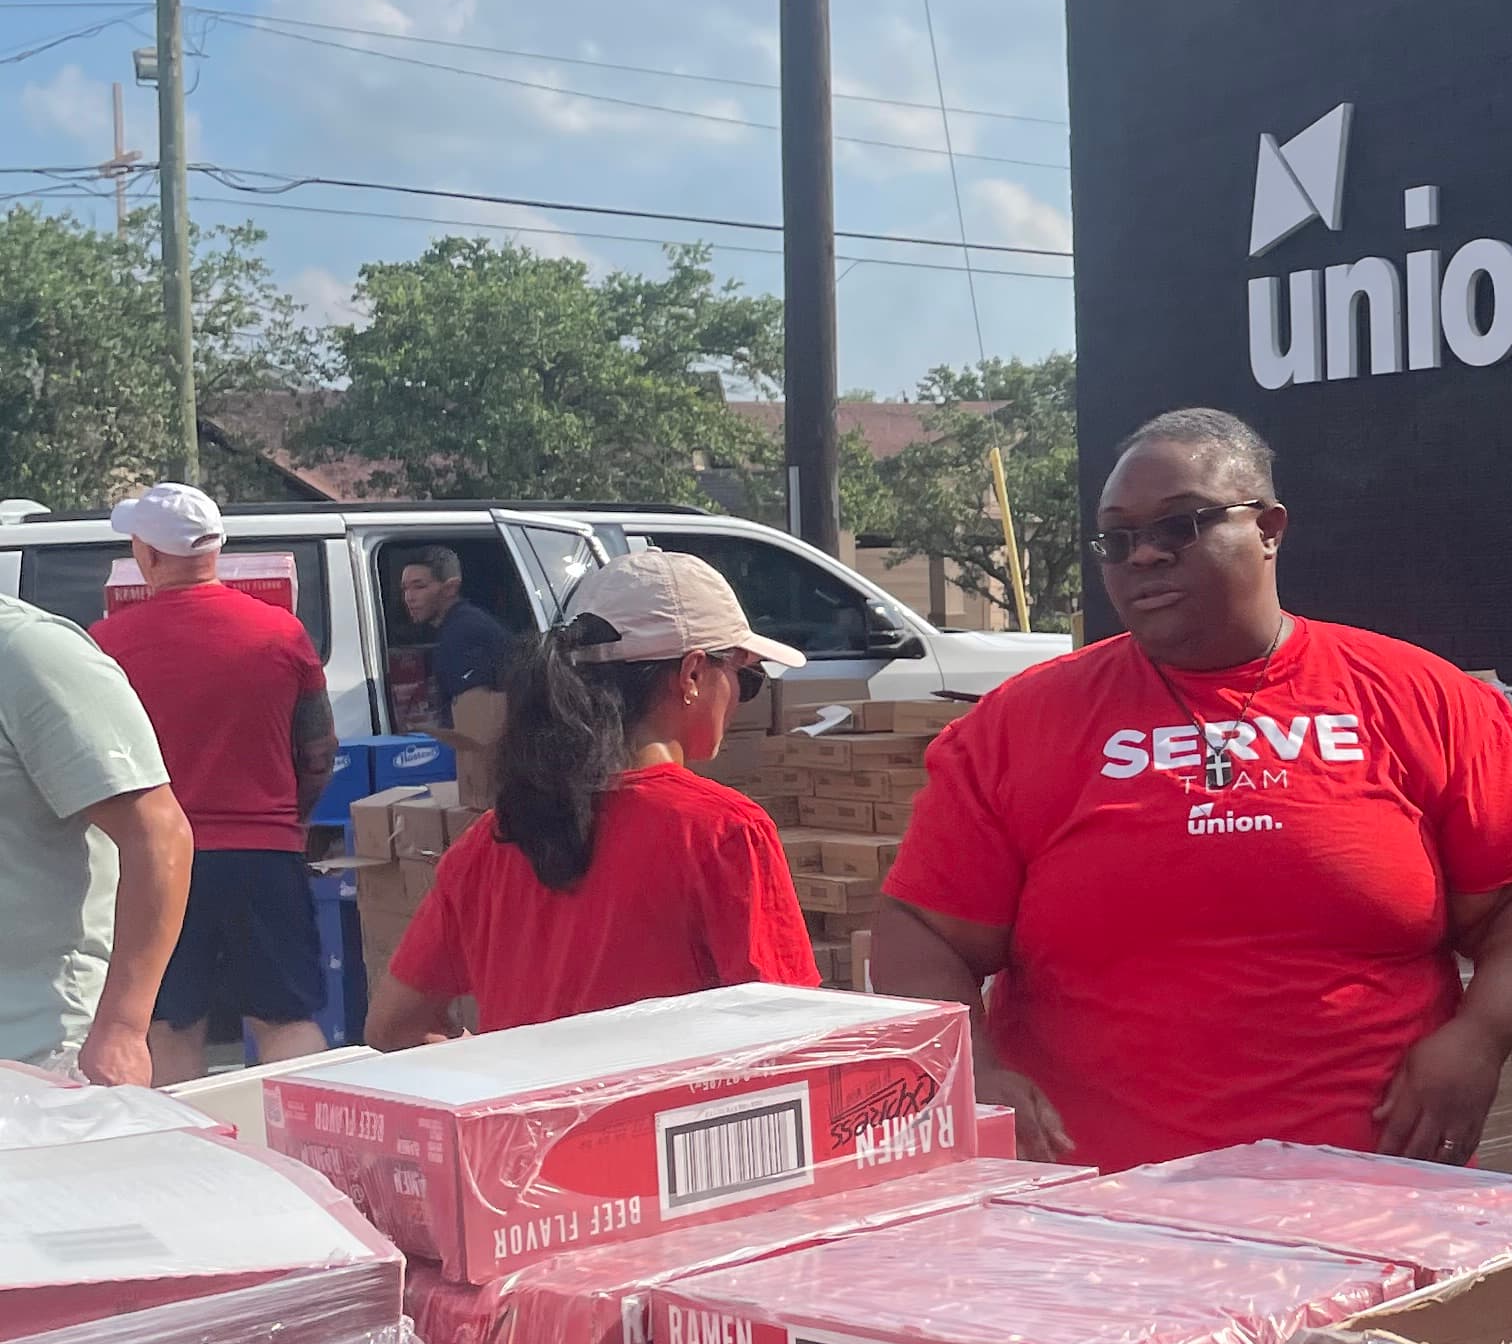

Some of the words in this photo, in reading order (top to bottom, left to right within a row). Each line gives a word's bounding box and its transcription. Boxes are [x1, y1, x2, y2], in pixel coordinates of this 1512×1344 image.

[1101, 714, 1364, 779] SERVE
[1179, 769, 1289, 794] TAM
[1188, 812, 1282, 835] union.
[855, 1105, 954, 1170] RAMEN
[494, 1213, 580, 1258] FLAVOR
[590, 1194, 642, 1236] BEEF
